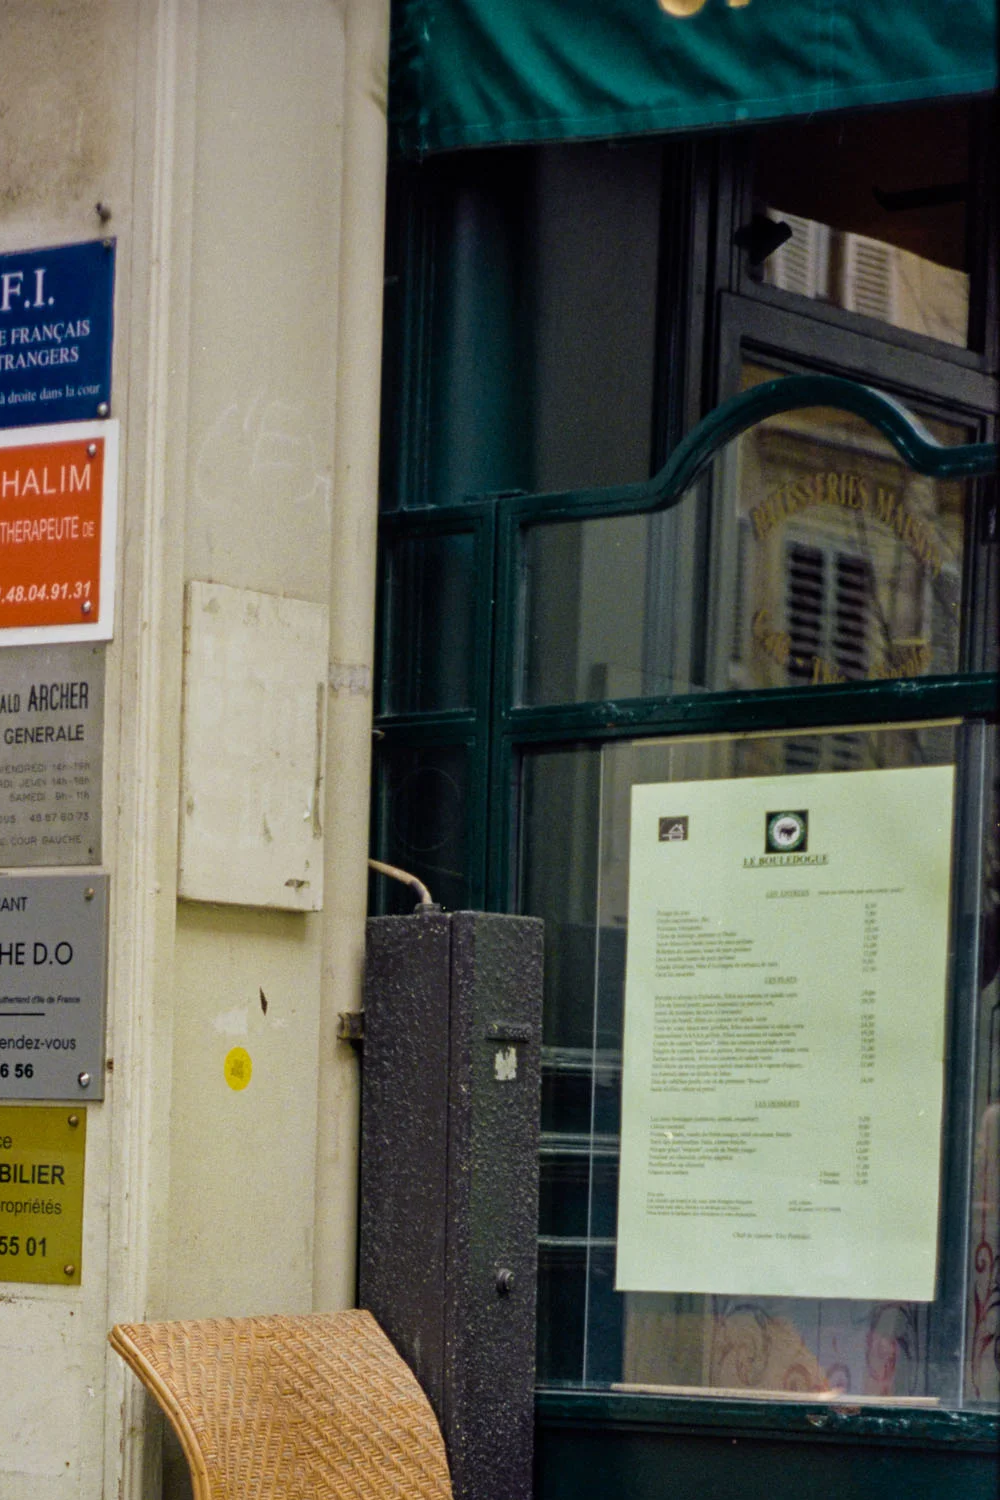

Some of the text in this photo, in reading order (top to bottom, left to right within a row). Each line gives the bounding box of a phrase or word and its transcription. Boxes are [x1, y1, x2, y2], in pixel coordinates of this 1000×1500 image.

[10, 319, 90, 346] FRANÇAIS
[7, 390, 37, 404] droite
[39, 387, 62, 400] dans
[65, 384, 75, 397] la
[77, 383, 100, 396] cour
[2, 463, 92, 498] HALIM
[27, 681, 90, 712] ARCHER
[4, 724, 84, 745] GENERALE
[33, 941, 73, 965] D.O
[15, 1064, 34, 1079] 56
[26, 1237, 47, 1257] 01
